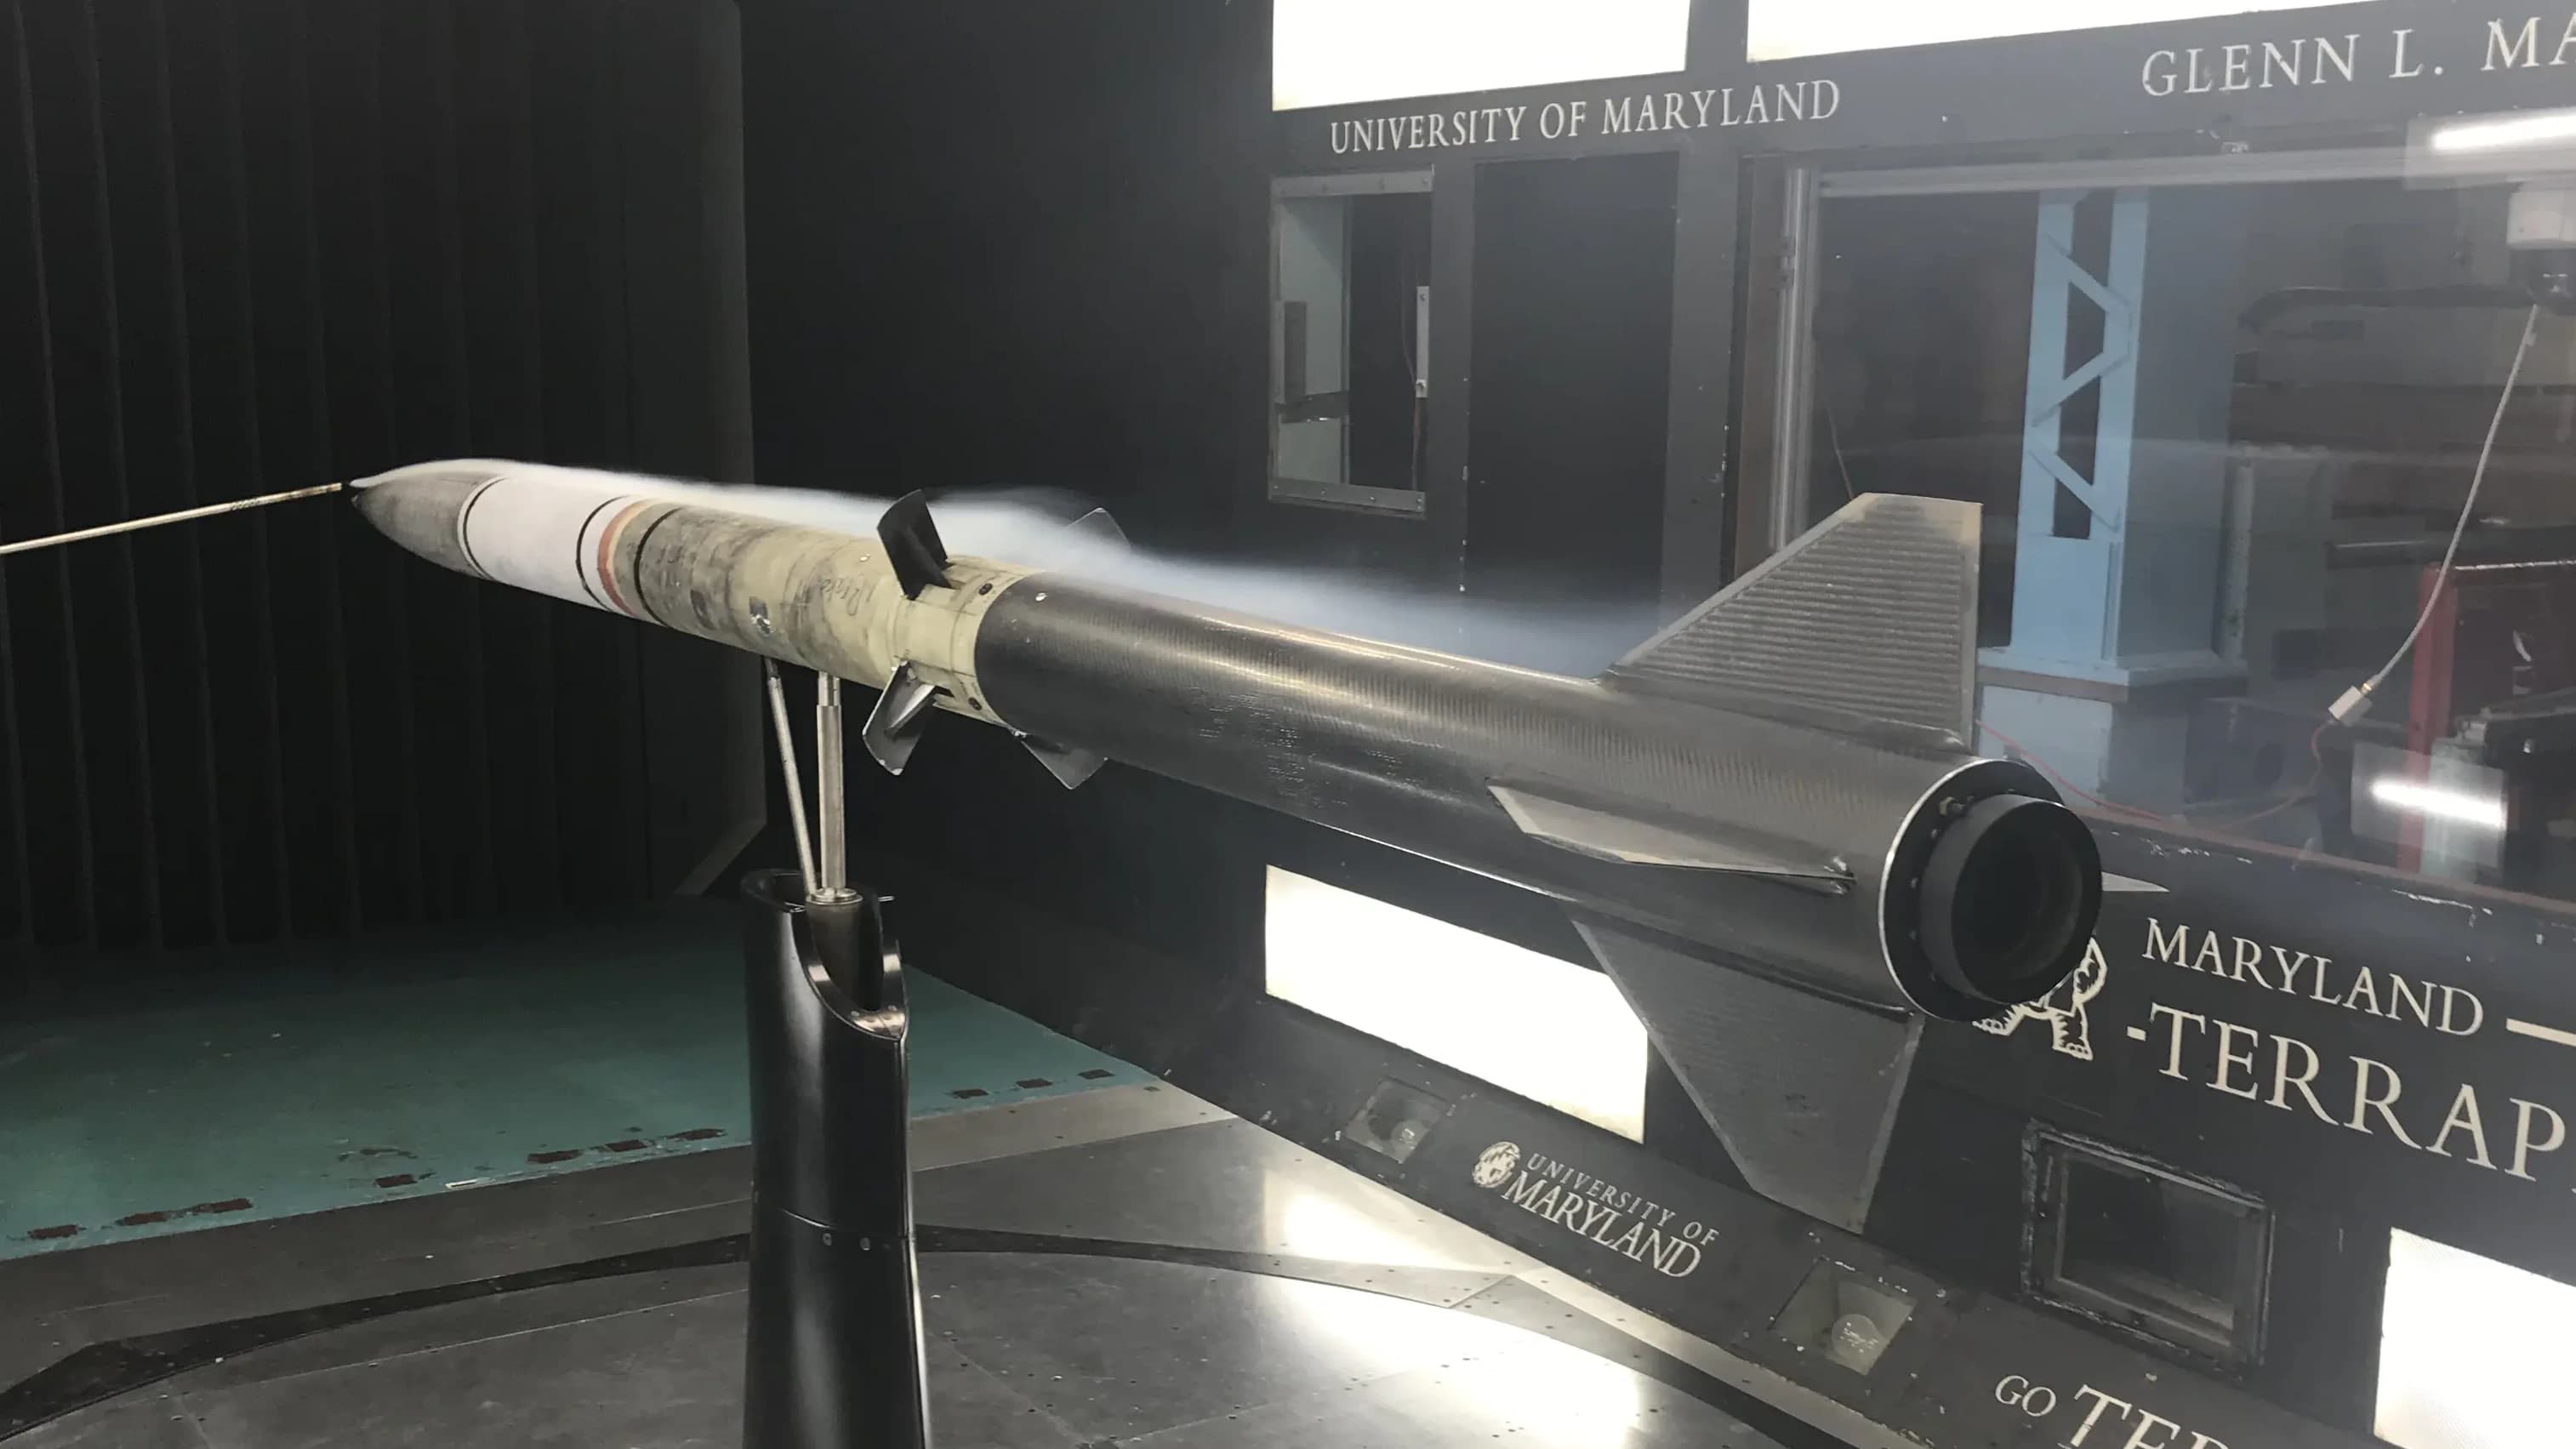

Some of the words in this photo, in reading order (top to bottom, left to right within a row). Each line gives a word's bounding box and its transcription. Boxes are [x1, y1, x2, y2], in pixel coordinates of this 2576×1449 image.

[2141, 34, 2360, 96] GLENN
[2389, 29, 2443, 78] L.
[1331, 105, 1526, 154] UNIVERSITY
[1539, 100, 1586, 139] OF
[1601, 79, 1839, 134] MARYLAND
[2142, 917, 2483, 1036] MARYLAND
[1501, 1171, 1701, 1277] MARYLAND
[1527, 1153, 1676, 1227] UNIVERSITY
[1682, 1221, 1719, 1246] OF
[1995, 1375, 2056, 1417] GO
